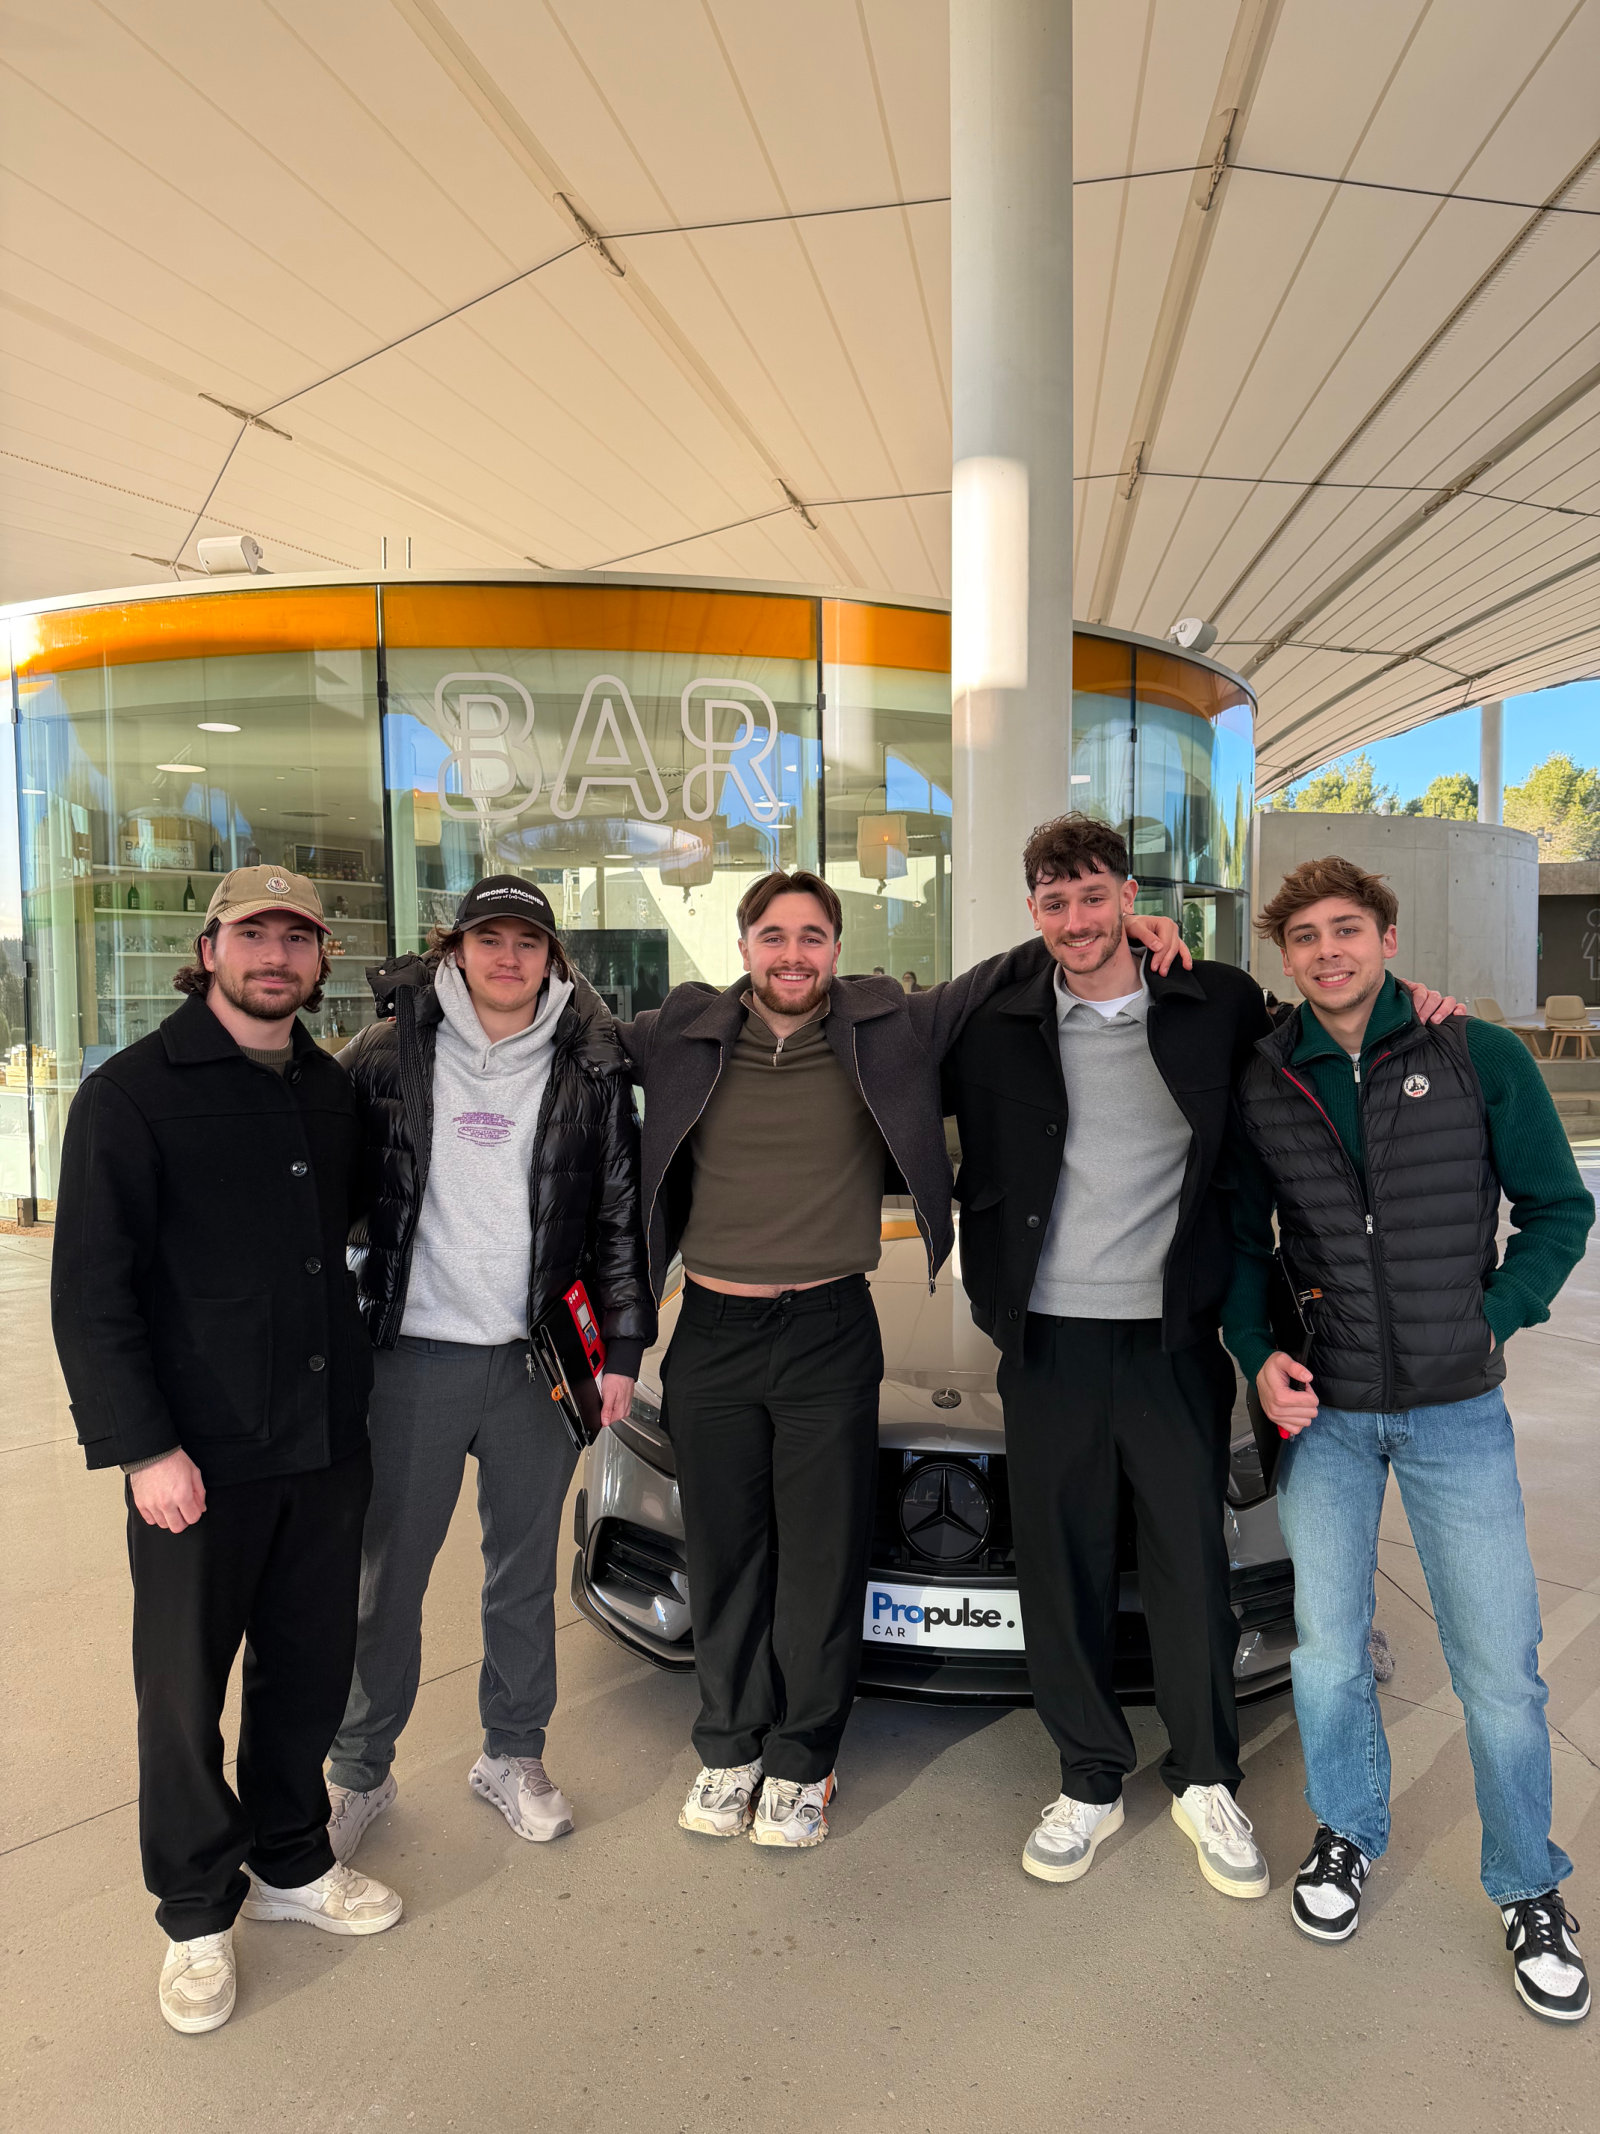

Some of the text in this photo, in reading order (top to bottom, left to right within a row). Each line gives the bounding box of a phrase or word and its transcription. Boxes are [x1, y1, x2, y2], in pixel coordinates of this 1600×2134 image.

[434, 672, 780, 822] BAR
[476, 888, 509, 901] HEDONIC
[510, 888, 544, 907] MACHINES
[872, 1625, 906, 1637] CAR
